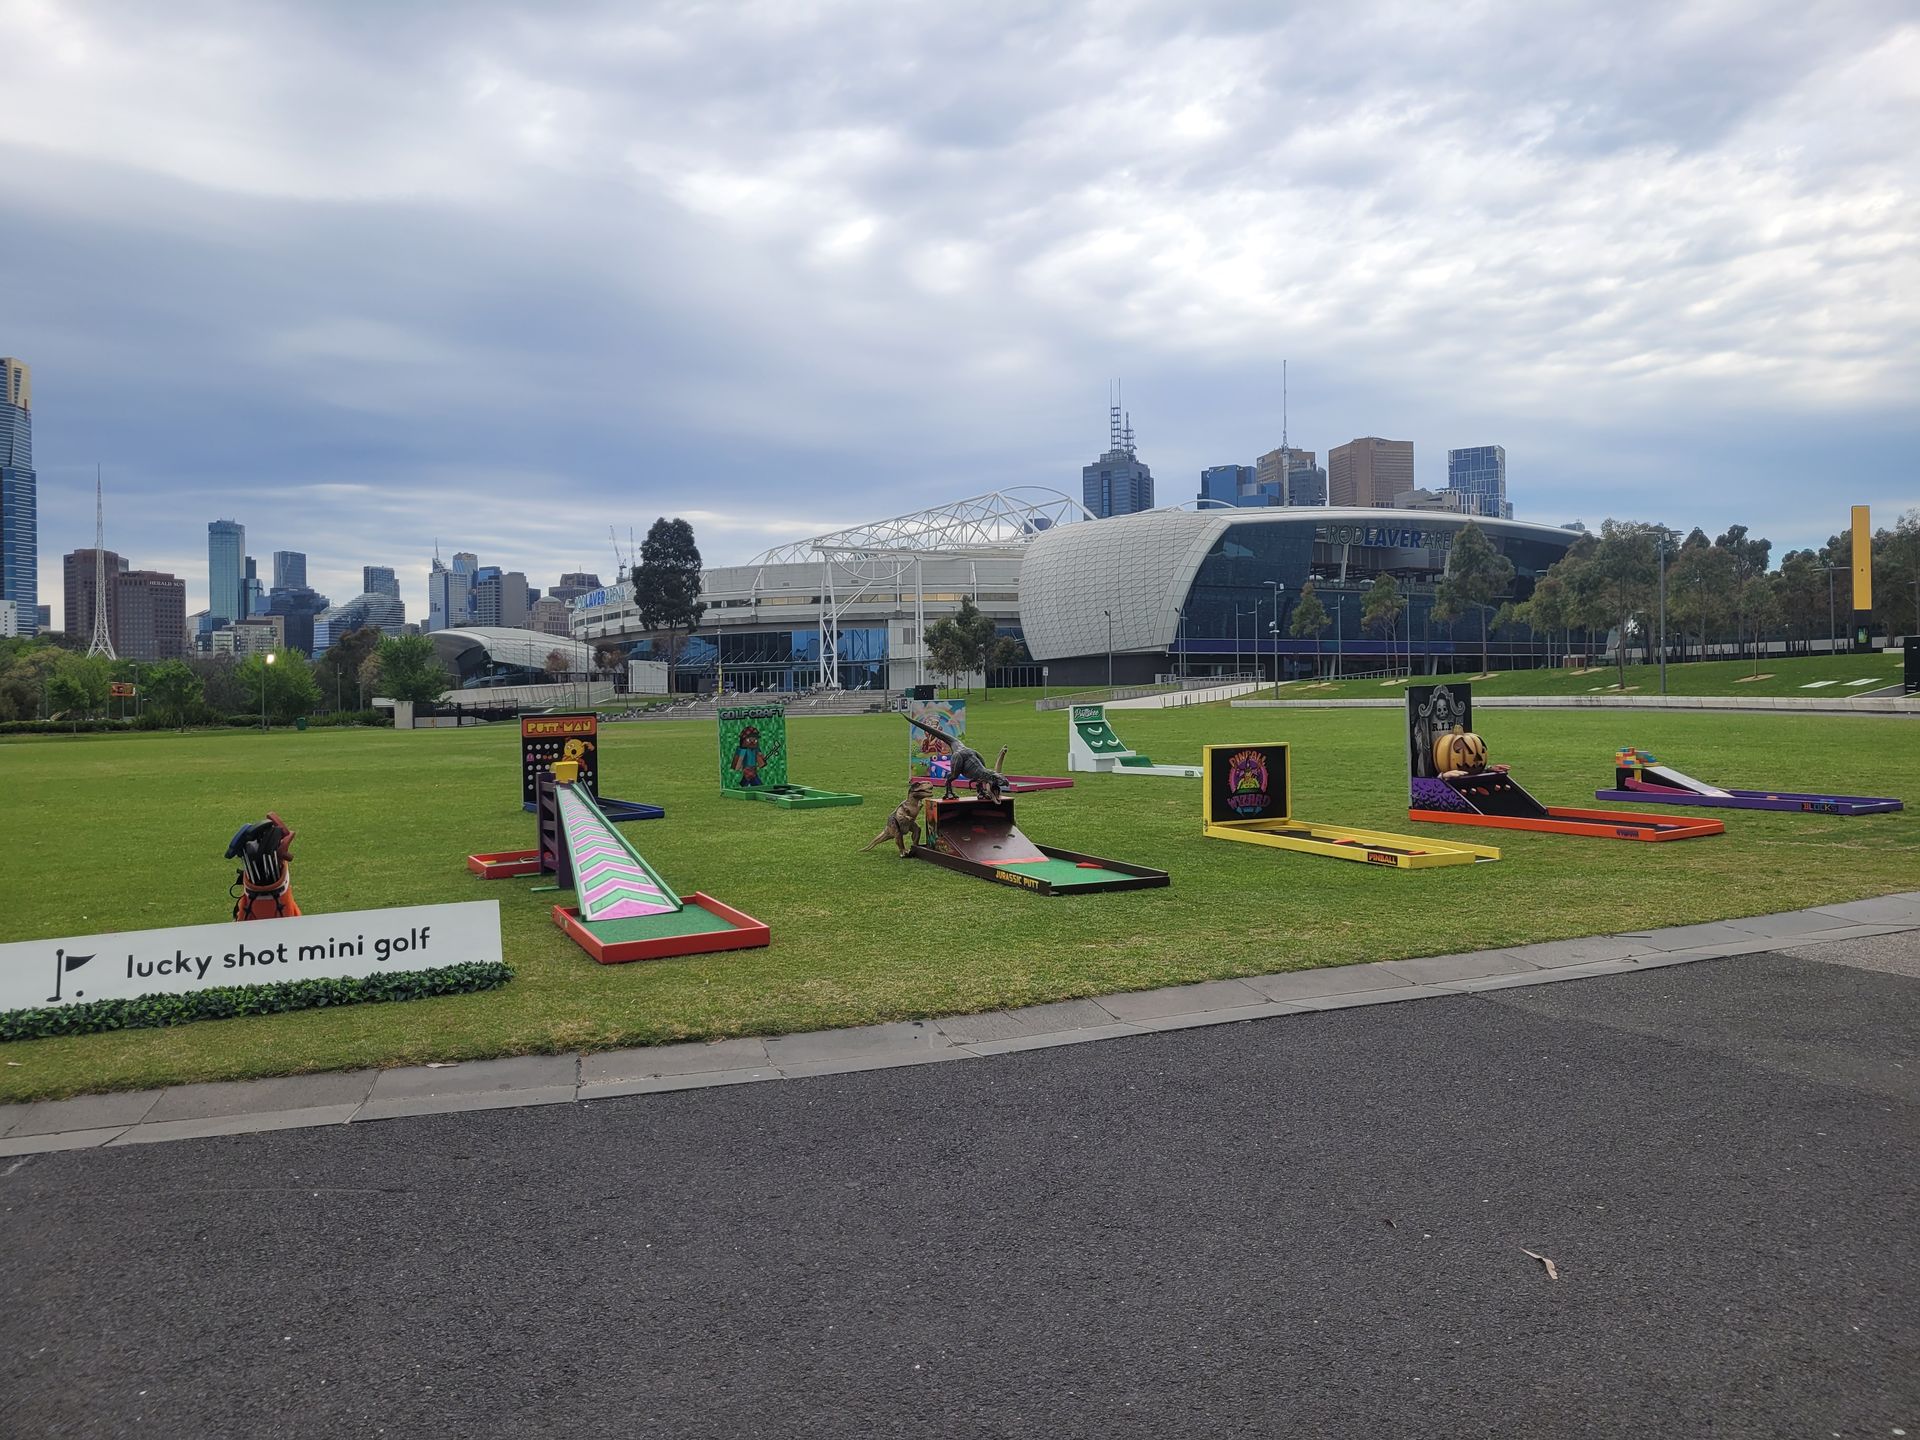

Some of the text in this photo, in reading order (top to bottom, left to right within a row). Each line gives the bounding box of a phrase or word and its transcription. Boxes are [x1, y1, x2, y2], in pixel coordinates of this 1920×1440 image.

[719, 706, 784, 720] GOLFCRAFT
[1801, 802, 1838, 812] BLOCKS
[1369, 853, 1397, 865] PINBALL
[995, 869, 1040, 890] JURASSIC PUTT
[126, 926, 431, 980] lucky shot mini golf
